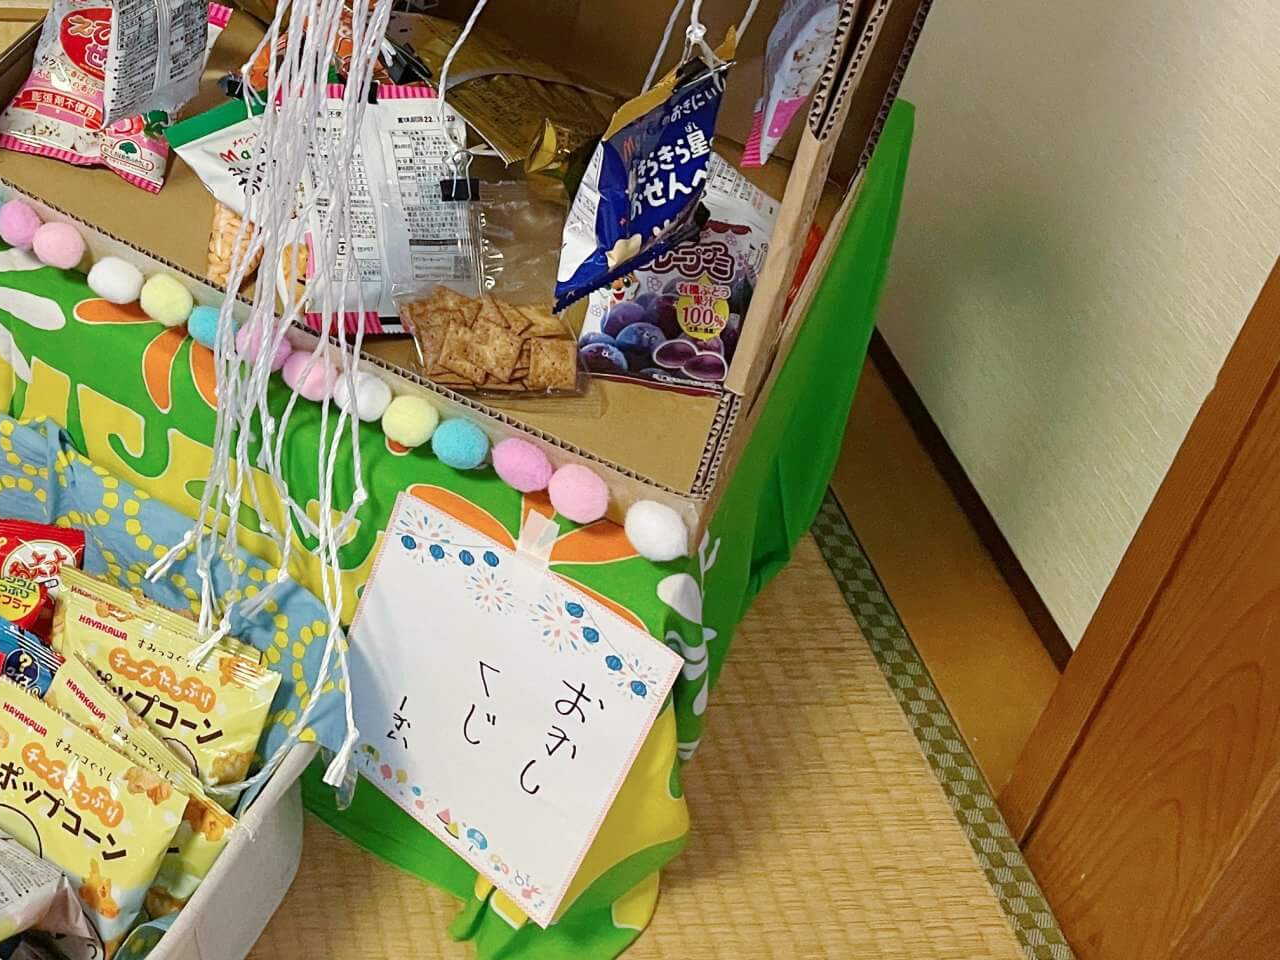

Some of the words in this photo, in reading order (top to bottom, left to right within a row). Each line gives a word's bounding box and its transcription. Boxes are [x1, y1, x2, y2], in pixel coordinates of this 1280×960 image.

[681, 306, 726, 328] 100%
[78, 614, 128, 641] HAYAKAWA
[66, 678, 107, 721] HAYAKAWA
[113, 652, 213, 709] チーズたっぷり
[2, 701, 48, 737] HAYAKAWA
[464, 660, 501, 746] くじ
[520, 680, 605, 795] おかし
